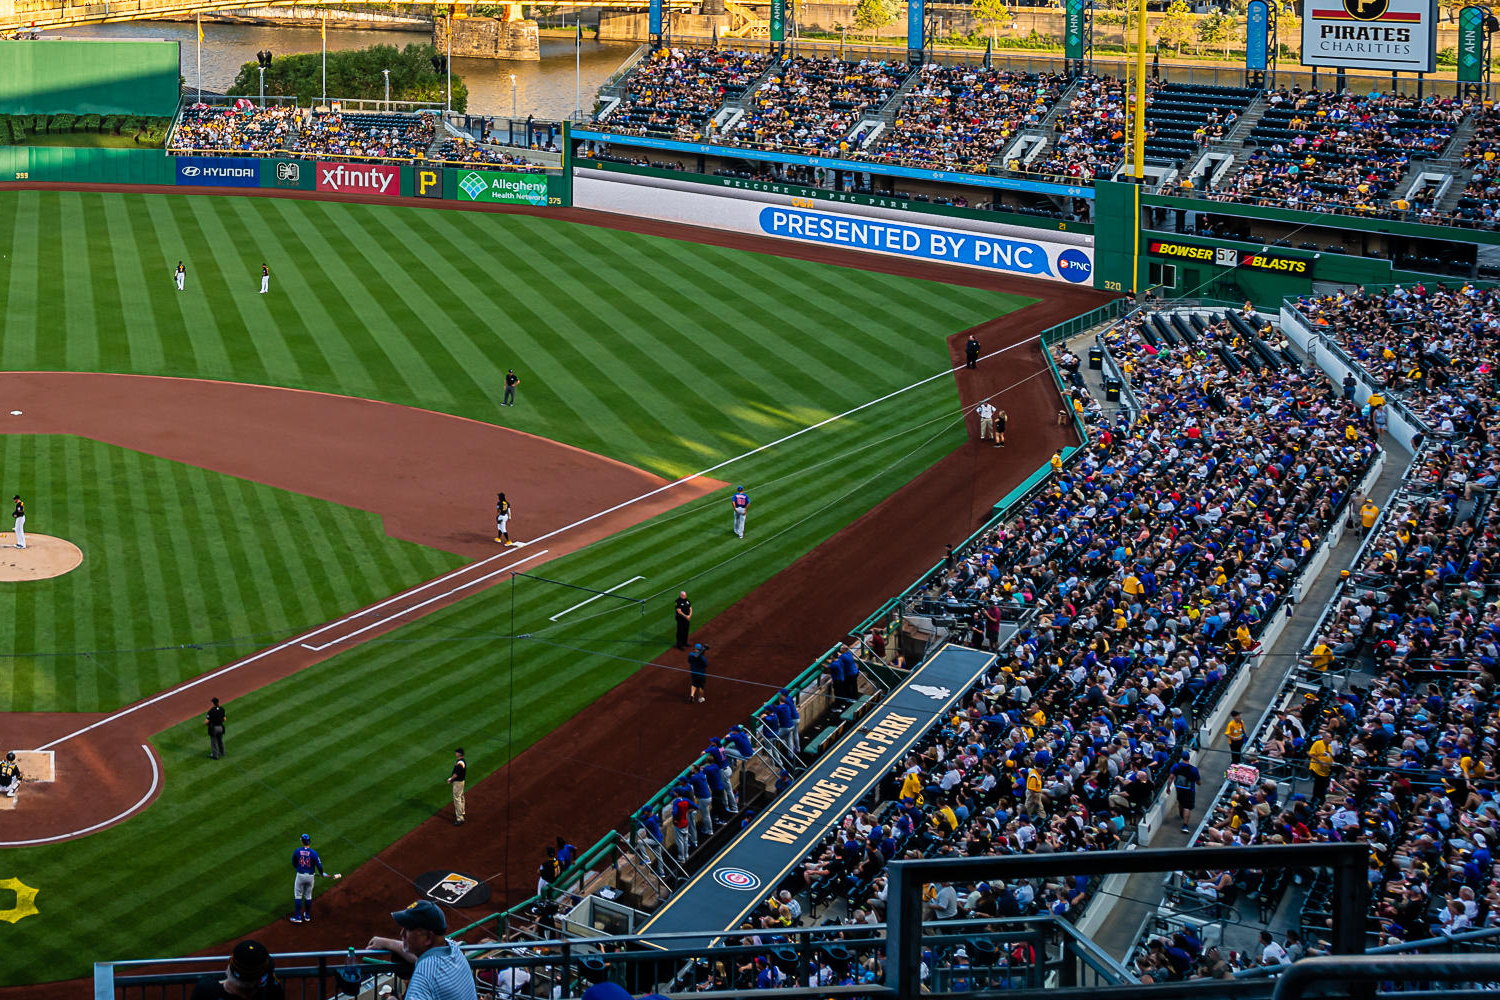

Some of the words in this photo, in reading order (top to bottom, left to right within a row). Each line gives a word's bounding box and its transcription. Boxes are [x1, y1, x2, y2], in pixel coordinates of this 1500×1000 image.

[1320, 25, 1411, 42] PIRATES
[1464, 30, 1476, 54] AHN
[1320, 41, 1411, 54] CHARITIES
[203, 167, 254, 177] HYUNDAI
[322, 165, 394, 193] xfinity
[419, 171, 437, 195] P
[492, 178, 546, 194] Allegheny
[492, 191, 515, 199] Health
[516, 193, 546, 202] Network
[548, 196, 562, 205] 375
[723, 179, 789, 194] WELCOME
[801, 189, 816, 197] TO
[829, 193, 856, 202] PNC
[869, 198, 909, 209] PARK
[791, 197, 814, 209] Q&A
[1058, 222, 1066, 230] 21
[773, 211, 921, 252] PRESENTED
[930, 234, 965, 257] BY
[974, 240, 1034, 270] PNC
[1069, 260, 1091, 272] PNC
[1159, 243, 1214, 261] BOWSER
[1251, 256, 1307, 273] BLASTS
[1104, 280, 1122, 291] 320
[869, 712, 918, 752] PARK
[843, 742, 880, 770] PNC
[830, 760, 859, 782] TO
[760, 779, 849, 845] WELCOME
[300, 856, 311, 867] 44
